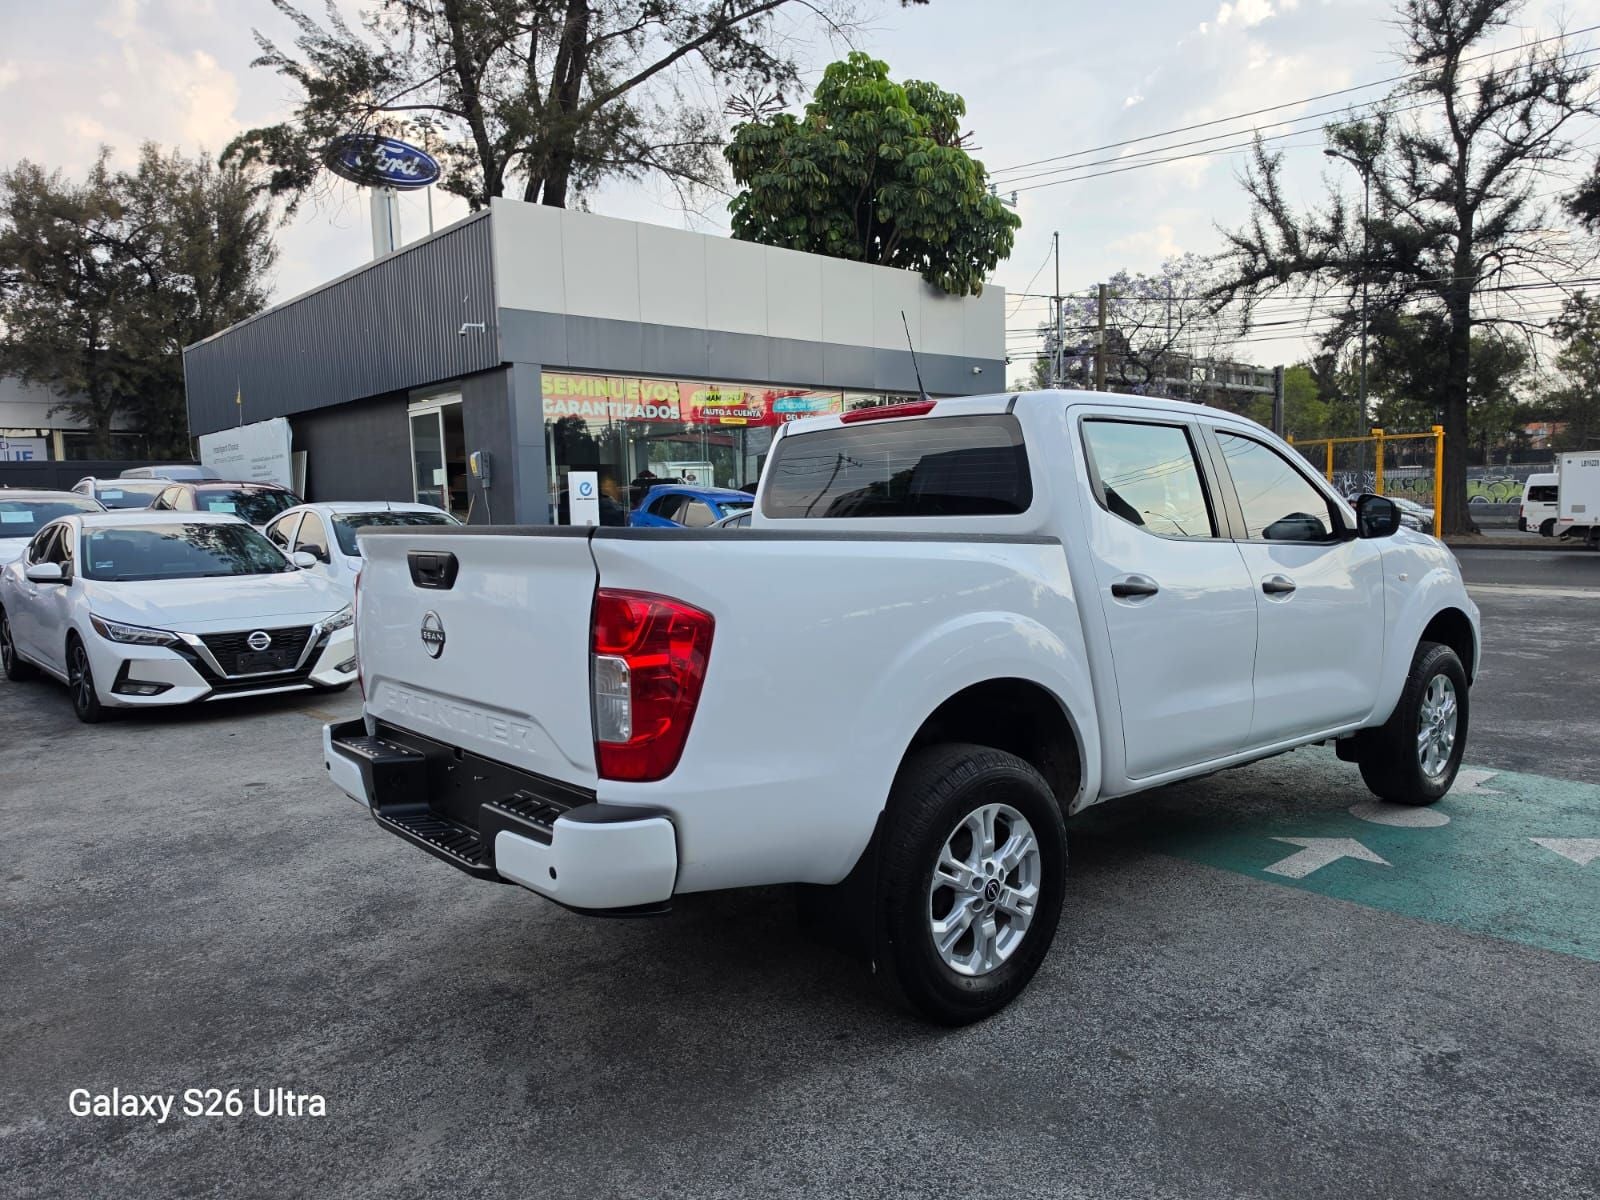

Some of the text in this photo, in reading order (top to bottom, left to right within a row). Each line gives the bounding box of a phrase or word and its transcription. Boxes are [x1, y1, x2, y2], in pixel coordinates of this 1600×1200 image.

[356, 144, 420, 175] Ford
[542, 376, 680, 402] SEMINUEVOS
[543, 398, 681, 420] GARANTIZADOS
[703, 408, 725, 416] AUTO
[734, 410, 762, 418] CUENTA
